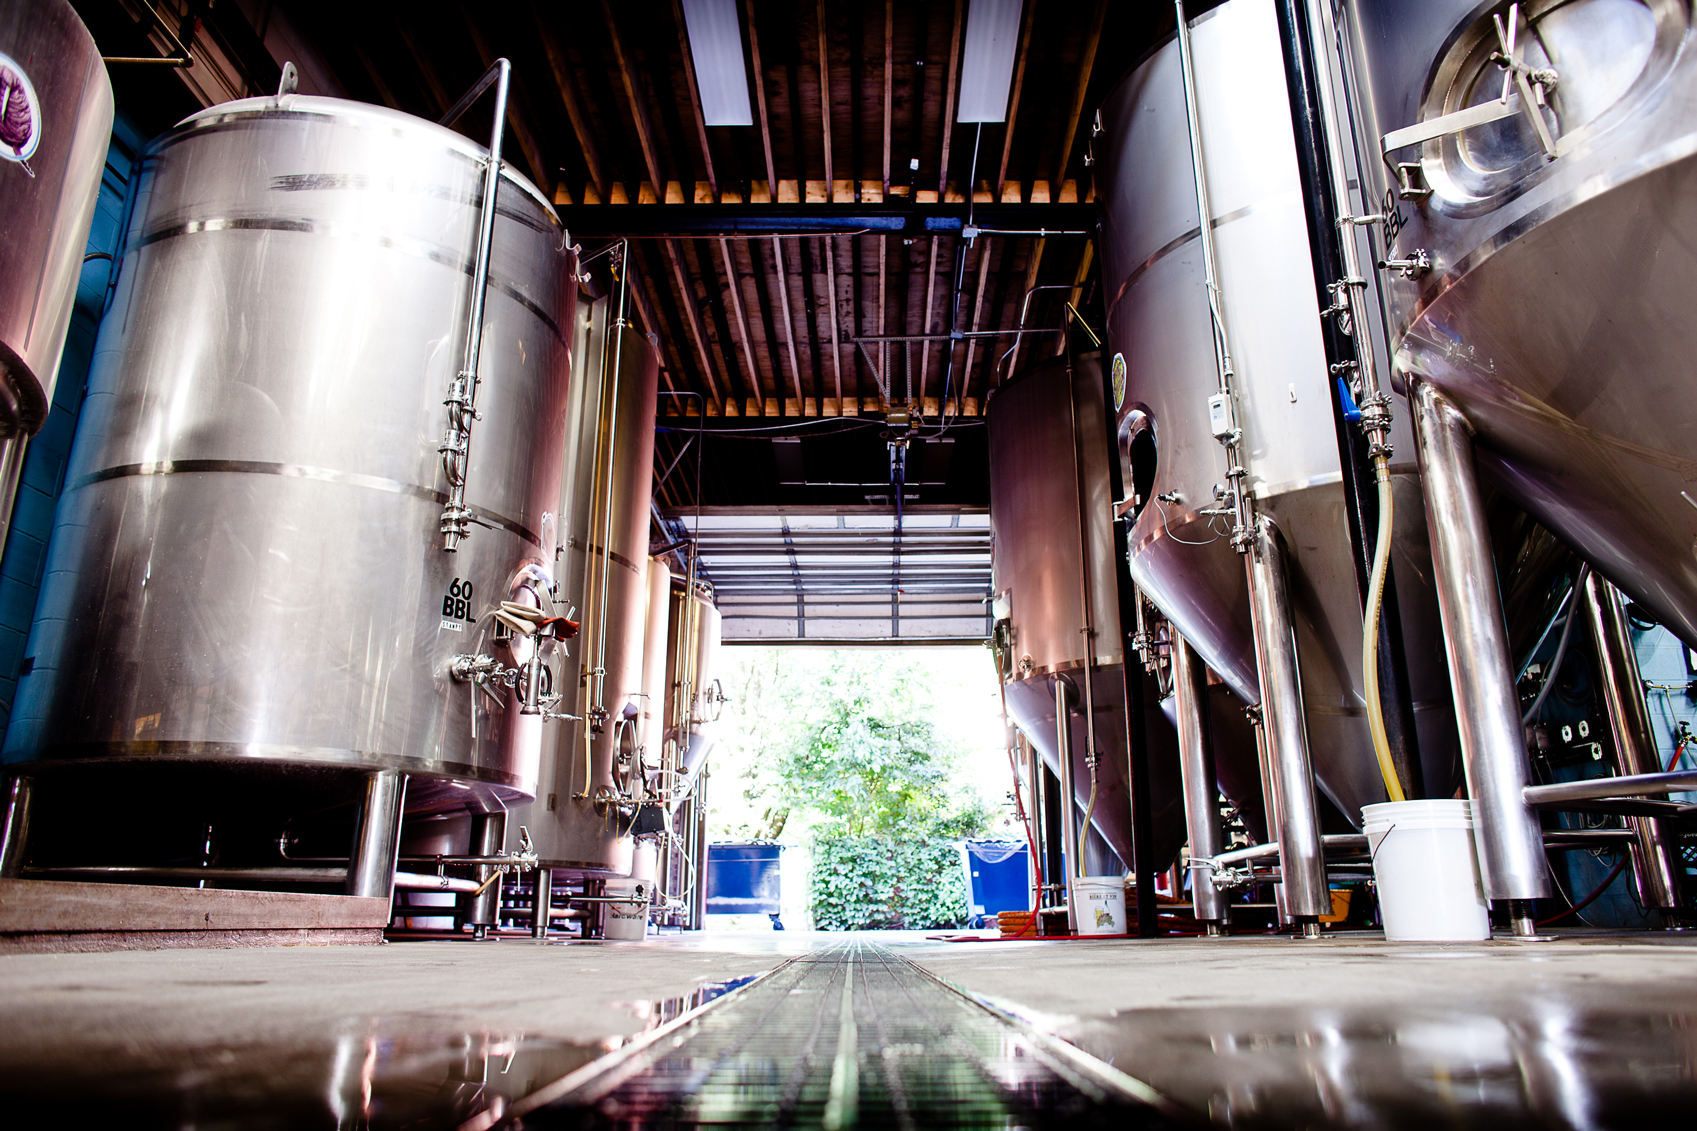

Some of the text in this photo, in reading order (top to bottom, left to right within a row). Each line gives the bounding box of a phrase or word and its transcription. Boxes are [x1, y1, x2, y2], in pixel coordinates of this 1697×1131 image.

[1383, 205, 1409, 251] BBL
[449, 577, 473, 601] 60
[442, 595, 476, 623] BBL
